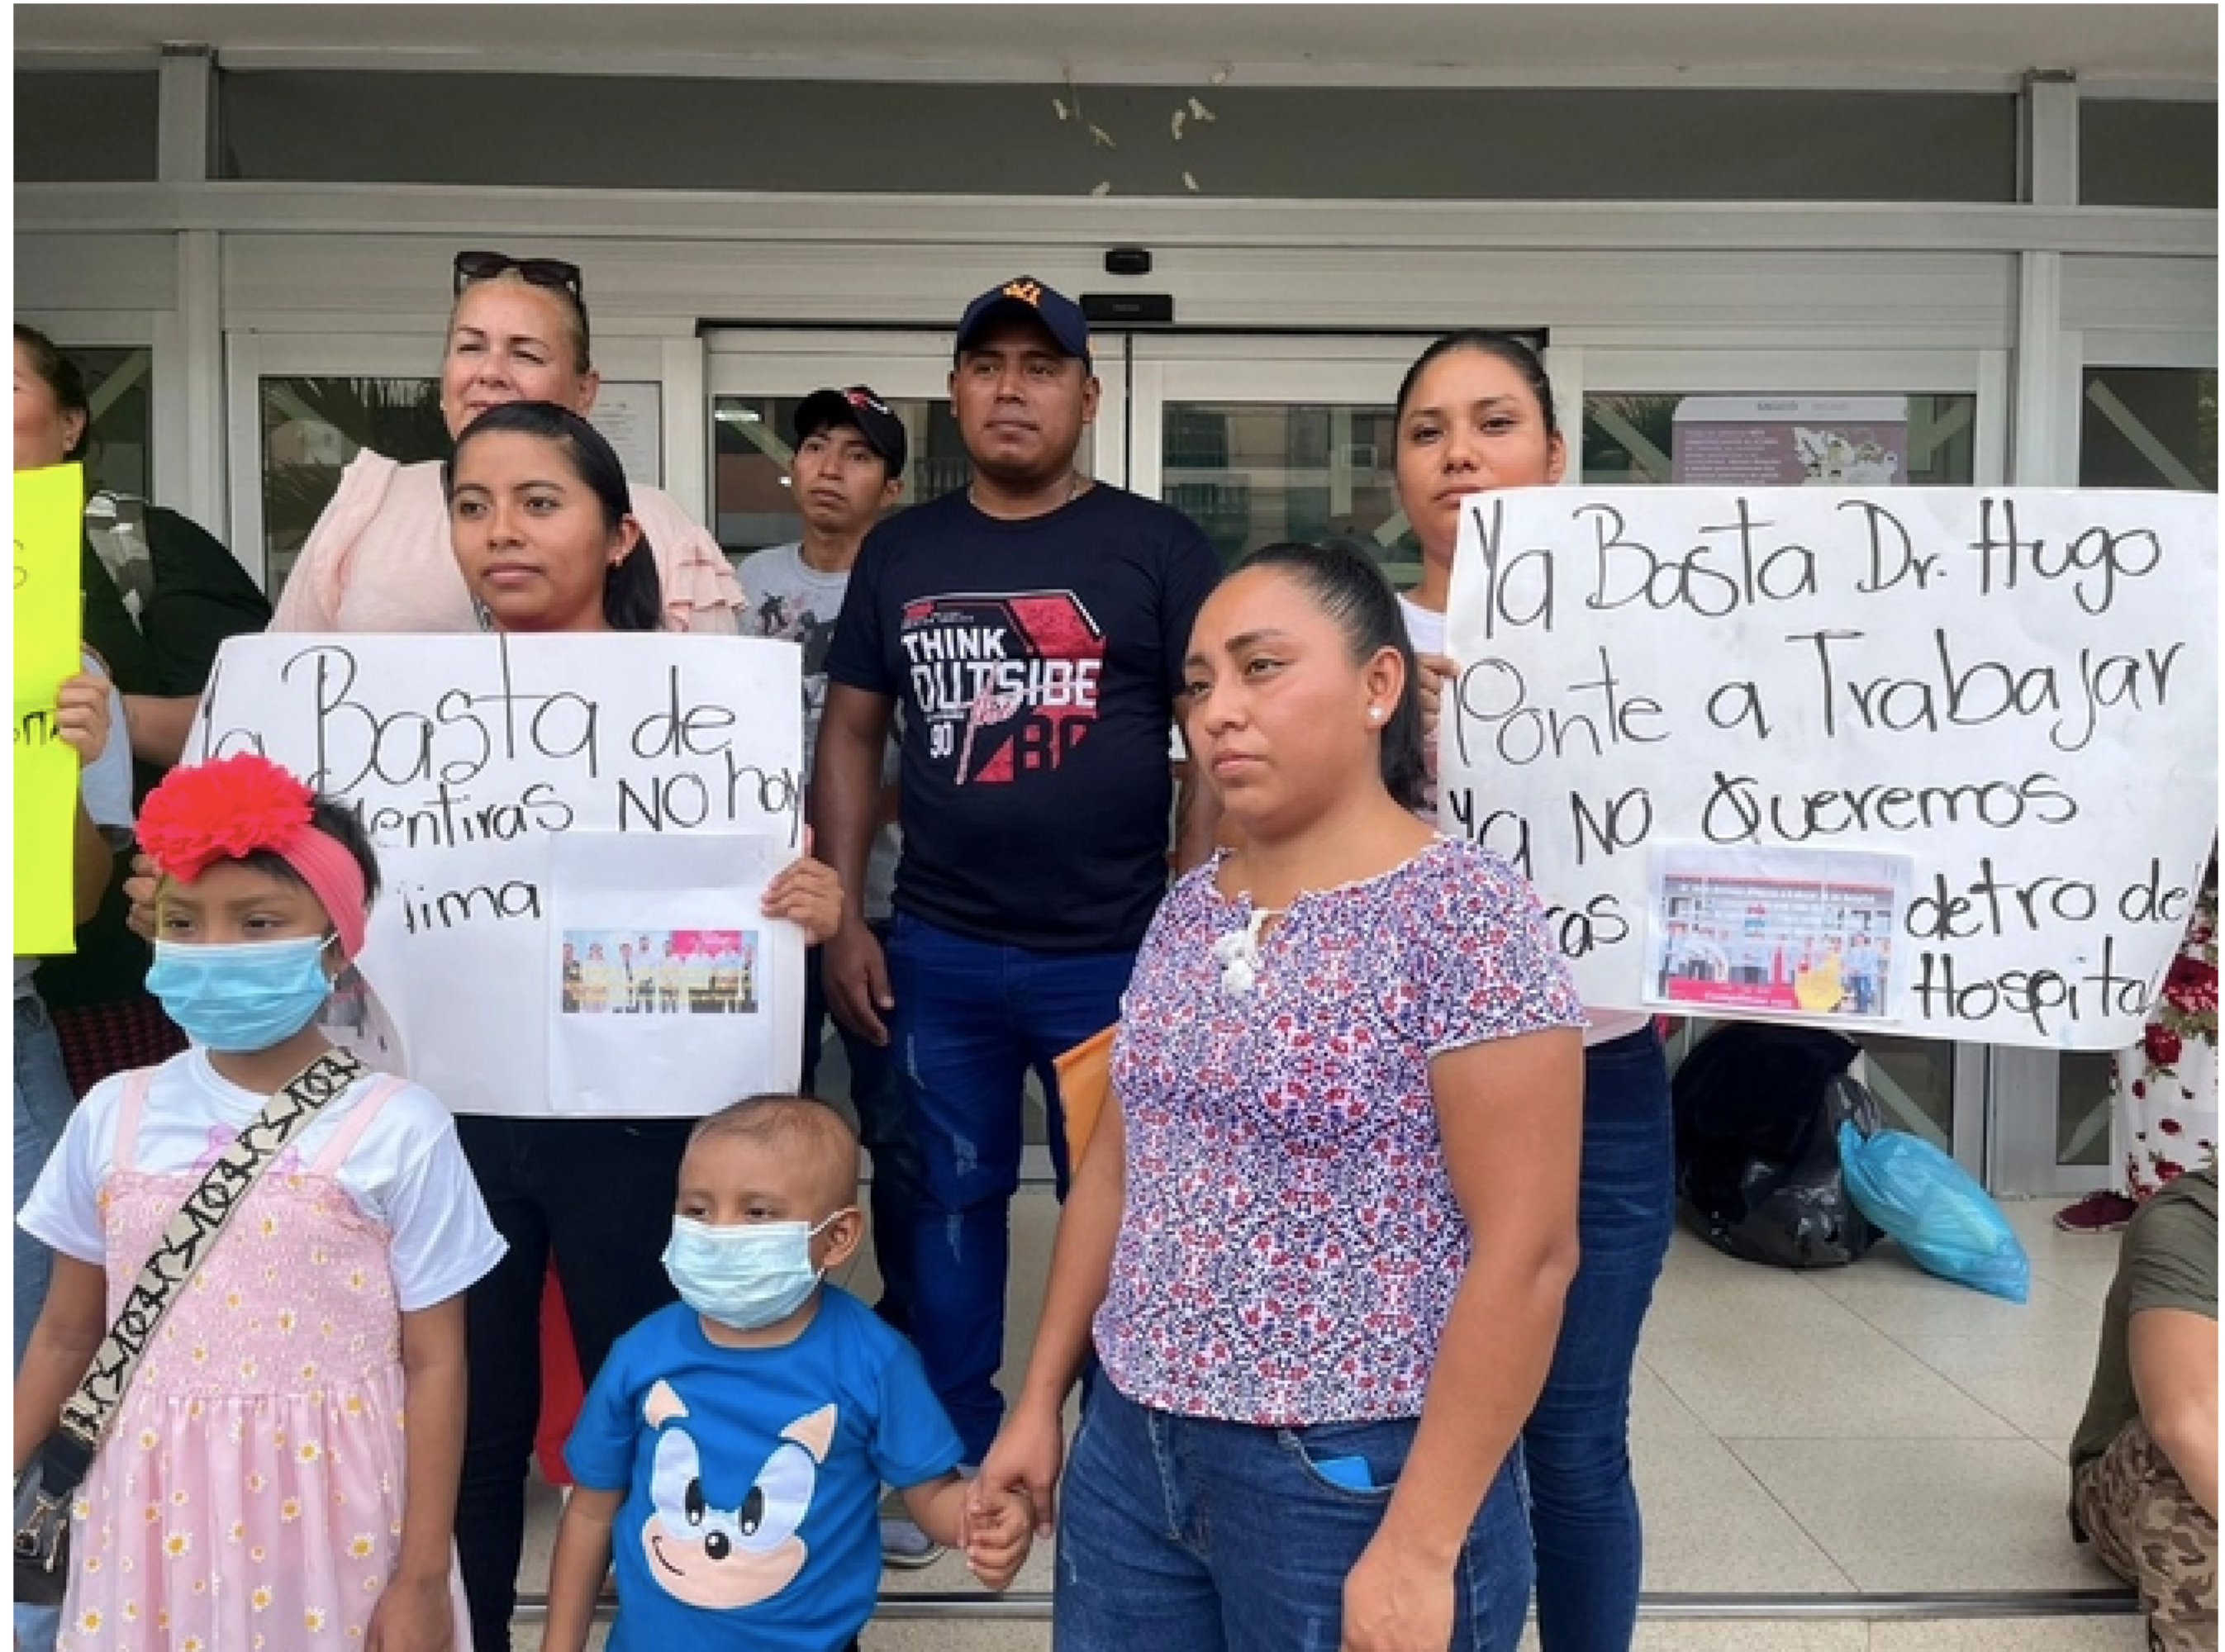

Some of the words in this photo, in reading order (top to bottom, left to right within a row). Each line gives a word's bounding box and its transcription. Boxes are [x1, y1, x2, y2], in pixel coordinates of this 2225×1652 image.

[1472, 497, 1553, 640] Ya
[1572, 496, 1818, 617] Basta
[1837, 499, 1947, 593] Dr.
[1968, 497, 2162, 615] Hugo
[901, 628, 1006, 662] THINK
[281, 632, 599, 797] Basta
[631, 664, 736, 758] de
[1452, 644, 1671, 767] Ponte
[1708, 680, 1774, 740] a
[1785, 627, 2186, 752] Trabajar
[355, 781, 574, 848] entiras
[617, 771, 710, 833] NO
[725, 749, 804, 848] hay
[1570, 786, 1653, 866] NO
[1701, 771, 2079, 844] Queremos
[1904, 856, 2098, 941] detro
